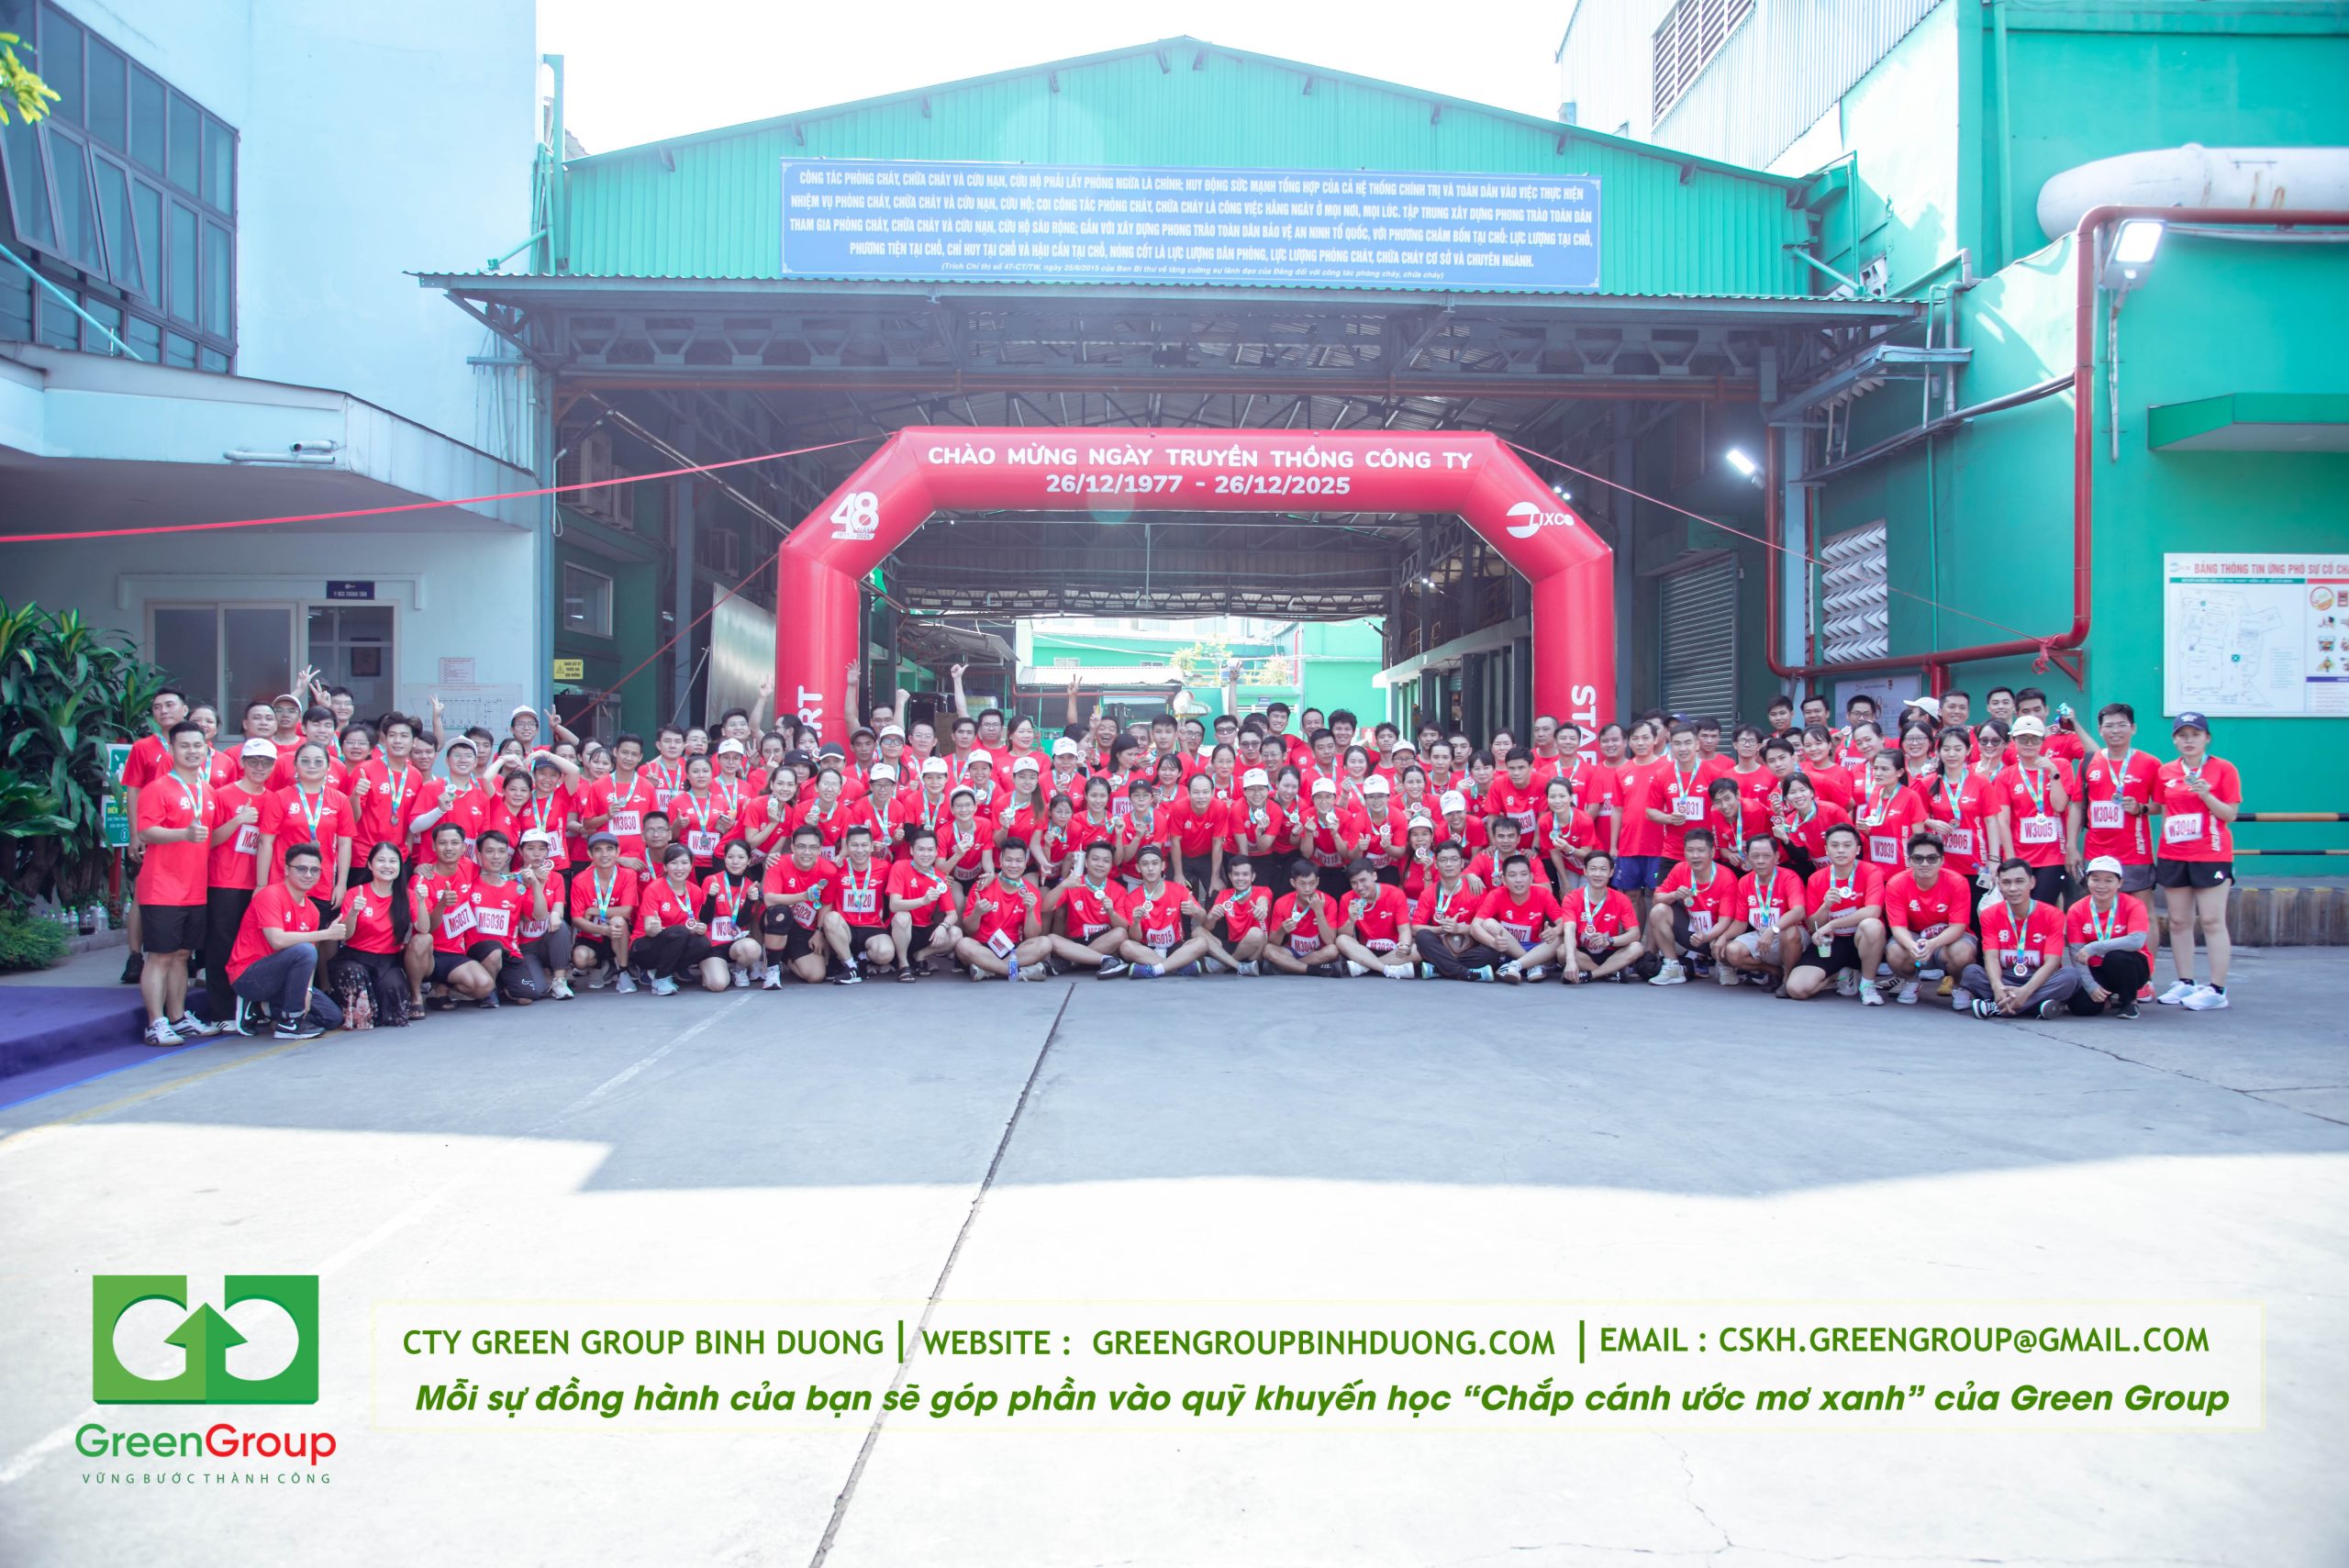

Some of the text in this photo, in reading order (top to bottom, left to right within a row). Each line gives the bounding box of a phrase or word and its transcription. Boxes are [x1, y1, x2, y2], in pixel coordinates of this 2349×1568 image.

[929, 440, 1473, 470] CHÀO MỪNG NGÀY TRUYỀN THỐNG CÔNG TY
[1046, 473, 1183, 495] 26/12/1977
[1215, 474, 1351, 495] 26/12/2025
[2252, 563, 2265, 573] TIN
[613, 816, 636, 830] M3030
[2024, 822, 2052, 838] W3005
[1874, 840, 1895, 858] W3039
[449, 907, 471, 931] M5037
[478, 912, 505, 929] M5036
